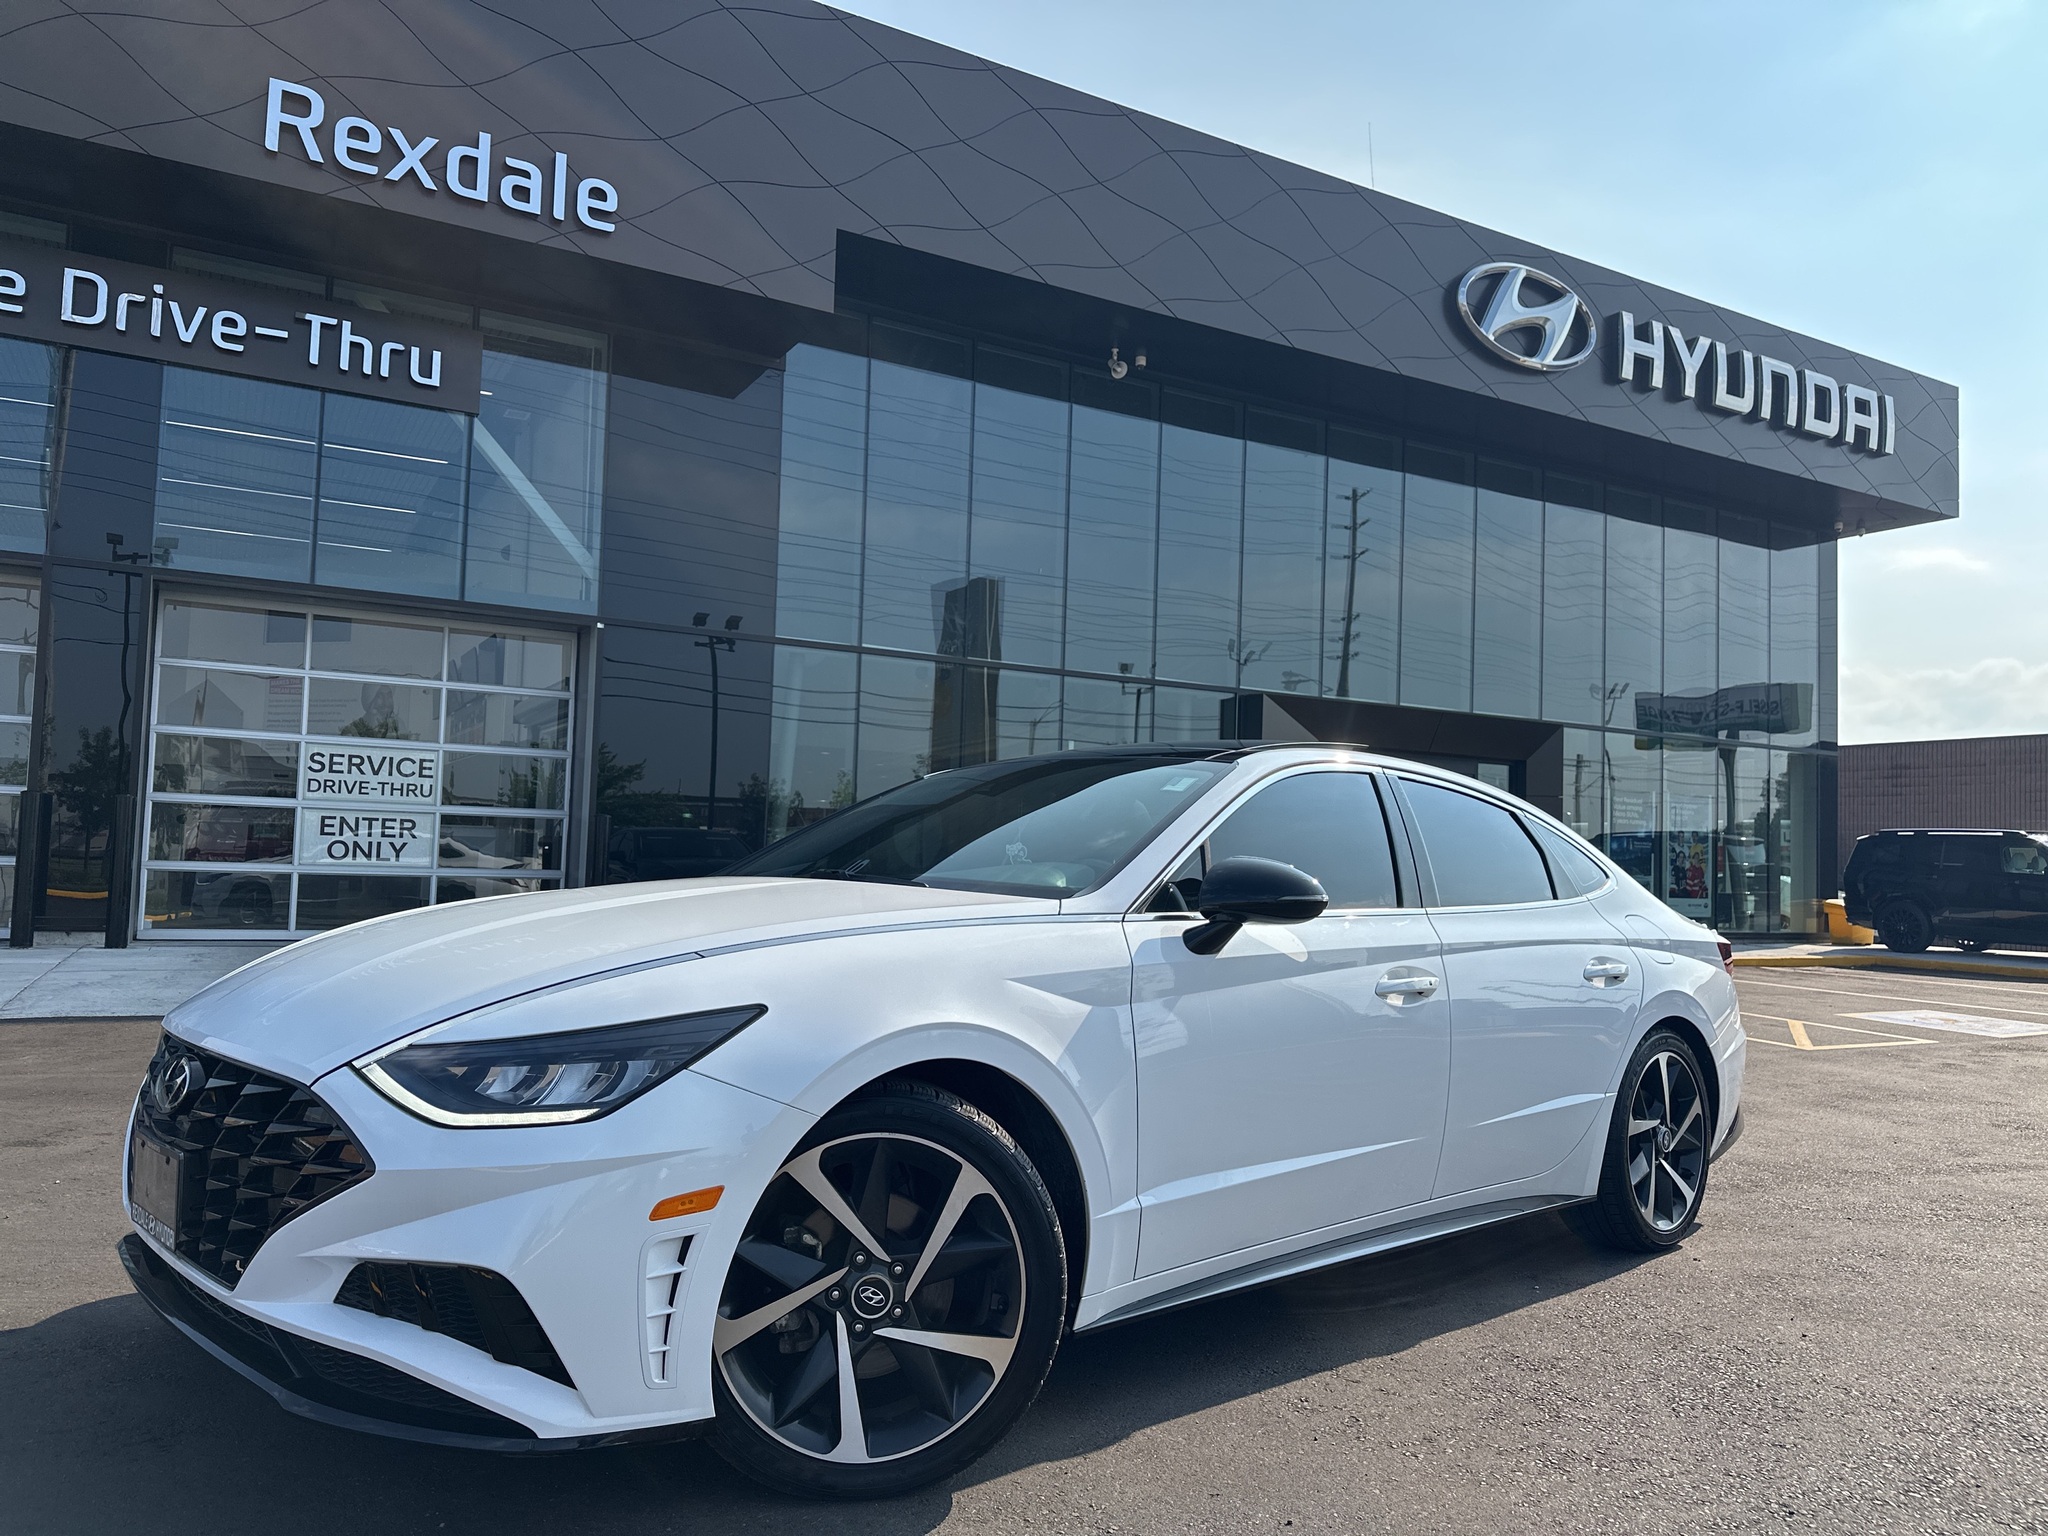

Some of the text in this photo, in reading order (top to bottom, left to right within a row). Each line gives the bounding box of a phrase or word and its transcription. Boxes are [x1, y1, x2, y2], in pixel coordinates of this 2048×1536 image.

[264, 76, 619, 233] Rexdale
[60, 267, 442, 388] Drive-Thru
[1618, 310, 1896, 456] HYUNDAI
[307, 752, 435, 779] SERVICE
[306, 778, 433, 798] DRIVE-THRU
[319, 815, 418, 840] ENTER
[327, 839, 409, 862] ONLY
